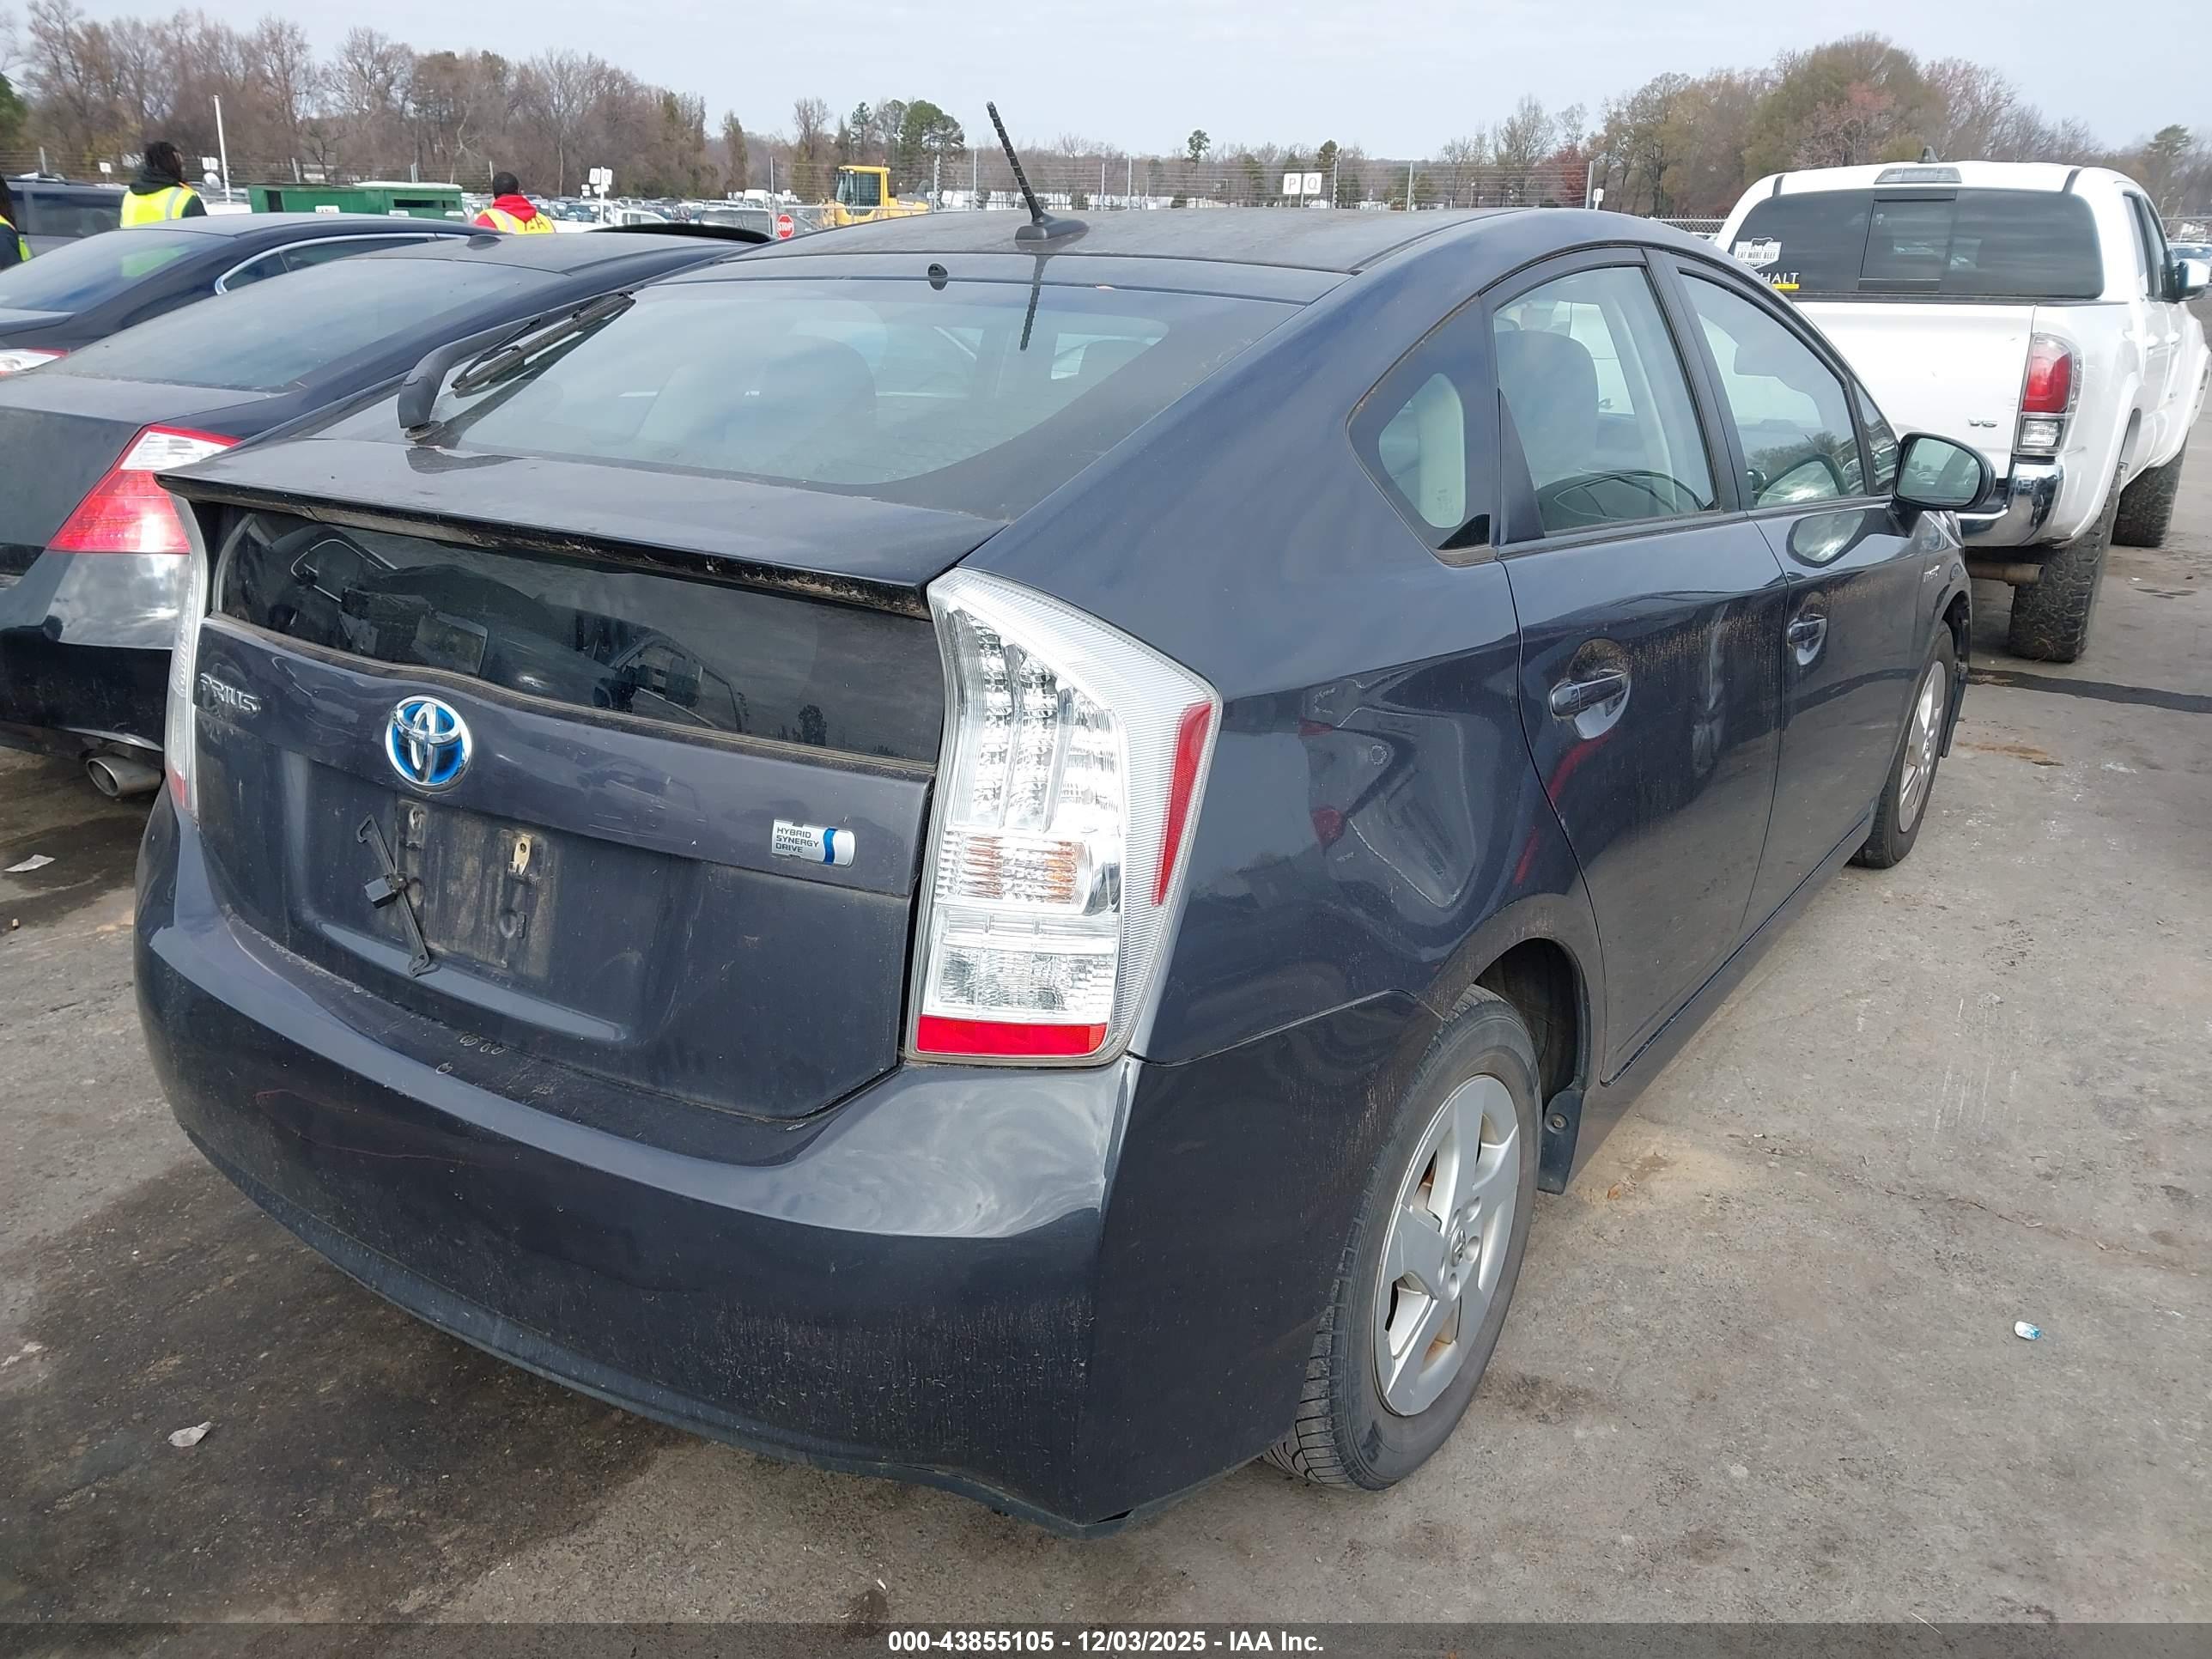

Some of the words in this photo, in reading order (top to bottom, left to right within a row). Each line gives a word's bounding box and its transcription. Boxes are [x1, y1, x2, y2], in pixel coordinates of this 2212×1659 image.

[1288, 178, 1297, 191] P
[1307, 177, 1318, 190] Q
[777, 222, 793, 232] STOP
[1747, 251, 1762, 259] MORE
[1759, 272, 1799, 284] HALT
[199, 672, 262, 713] PRIUS
[776, 826, 811, 839] HYBRID
[775, 835, 819, 848] SYNERGY
[775, 842, 804, 854] DRIVE
